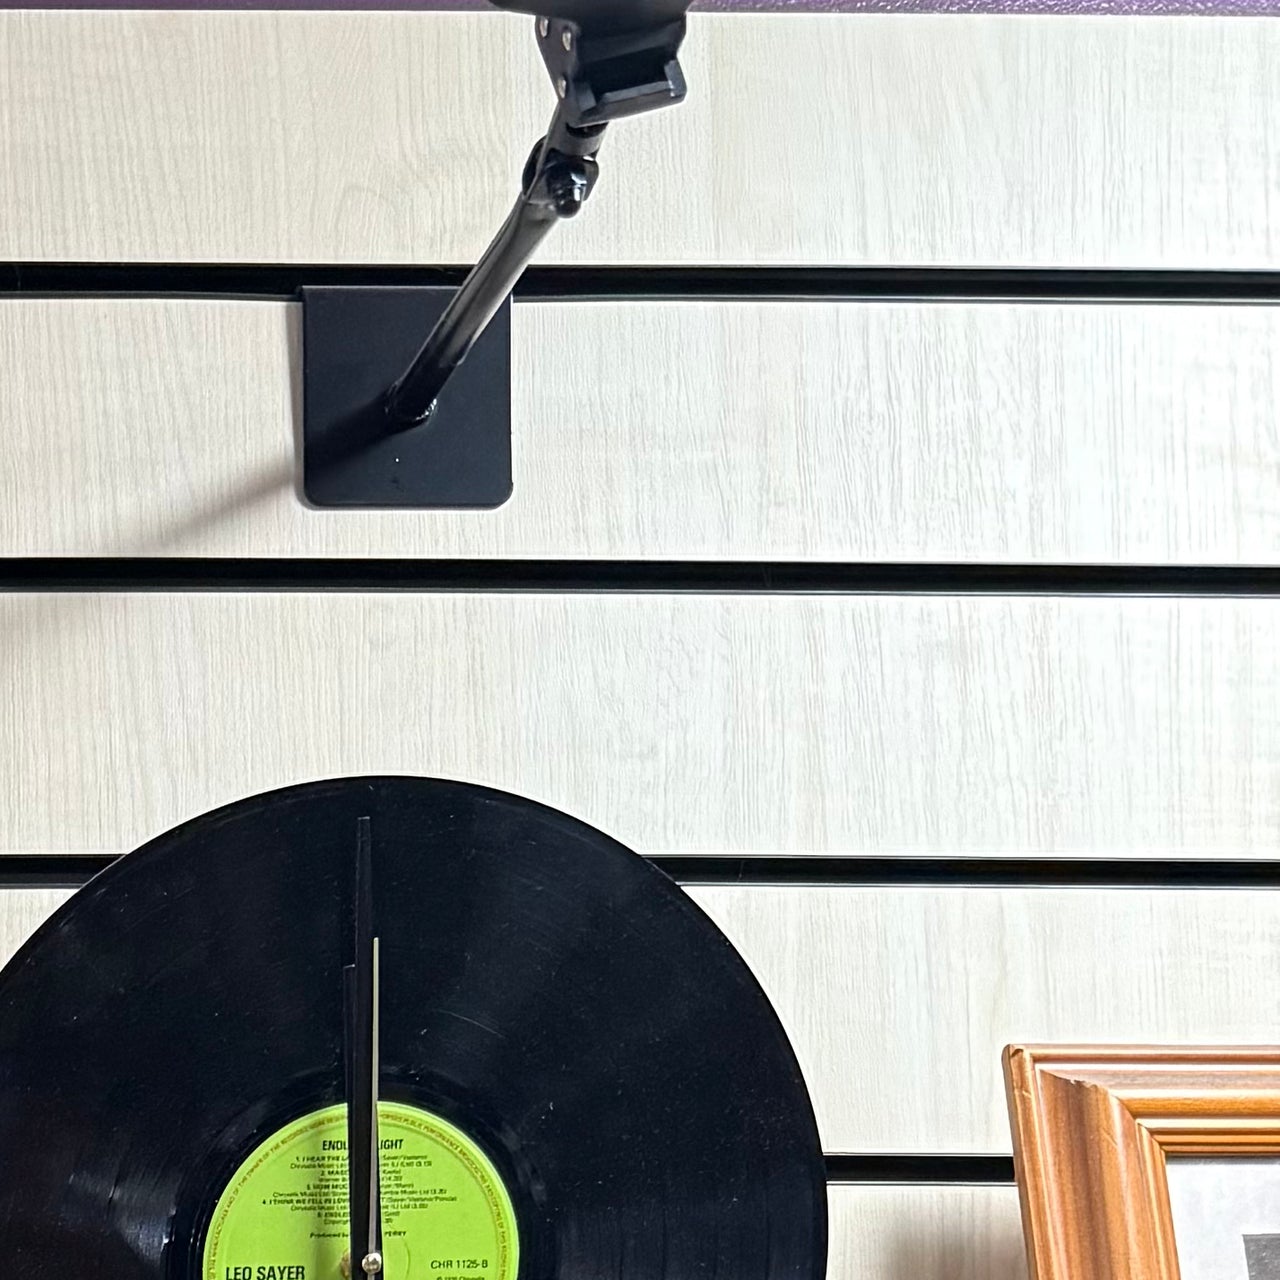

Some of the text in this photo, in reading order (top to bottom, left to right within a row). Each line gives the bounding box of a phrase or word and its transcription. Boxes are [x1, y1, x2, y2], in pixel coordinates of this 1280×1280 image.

[322, 1138, 404, 1151] ENDL IGHT
[430, 1259, 453, 1269] CHR
